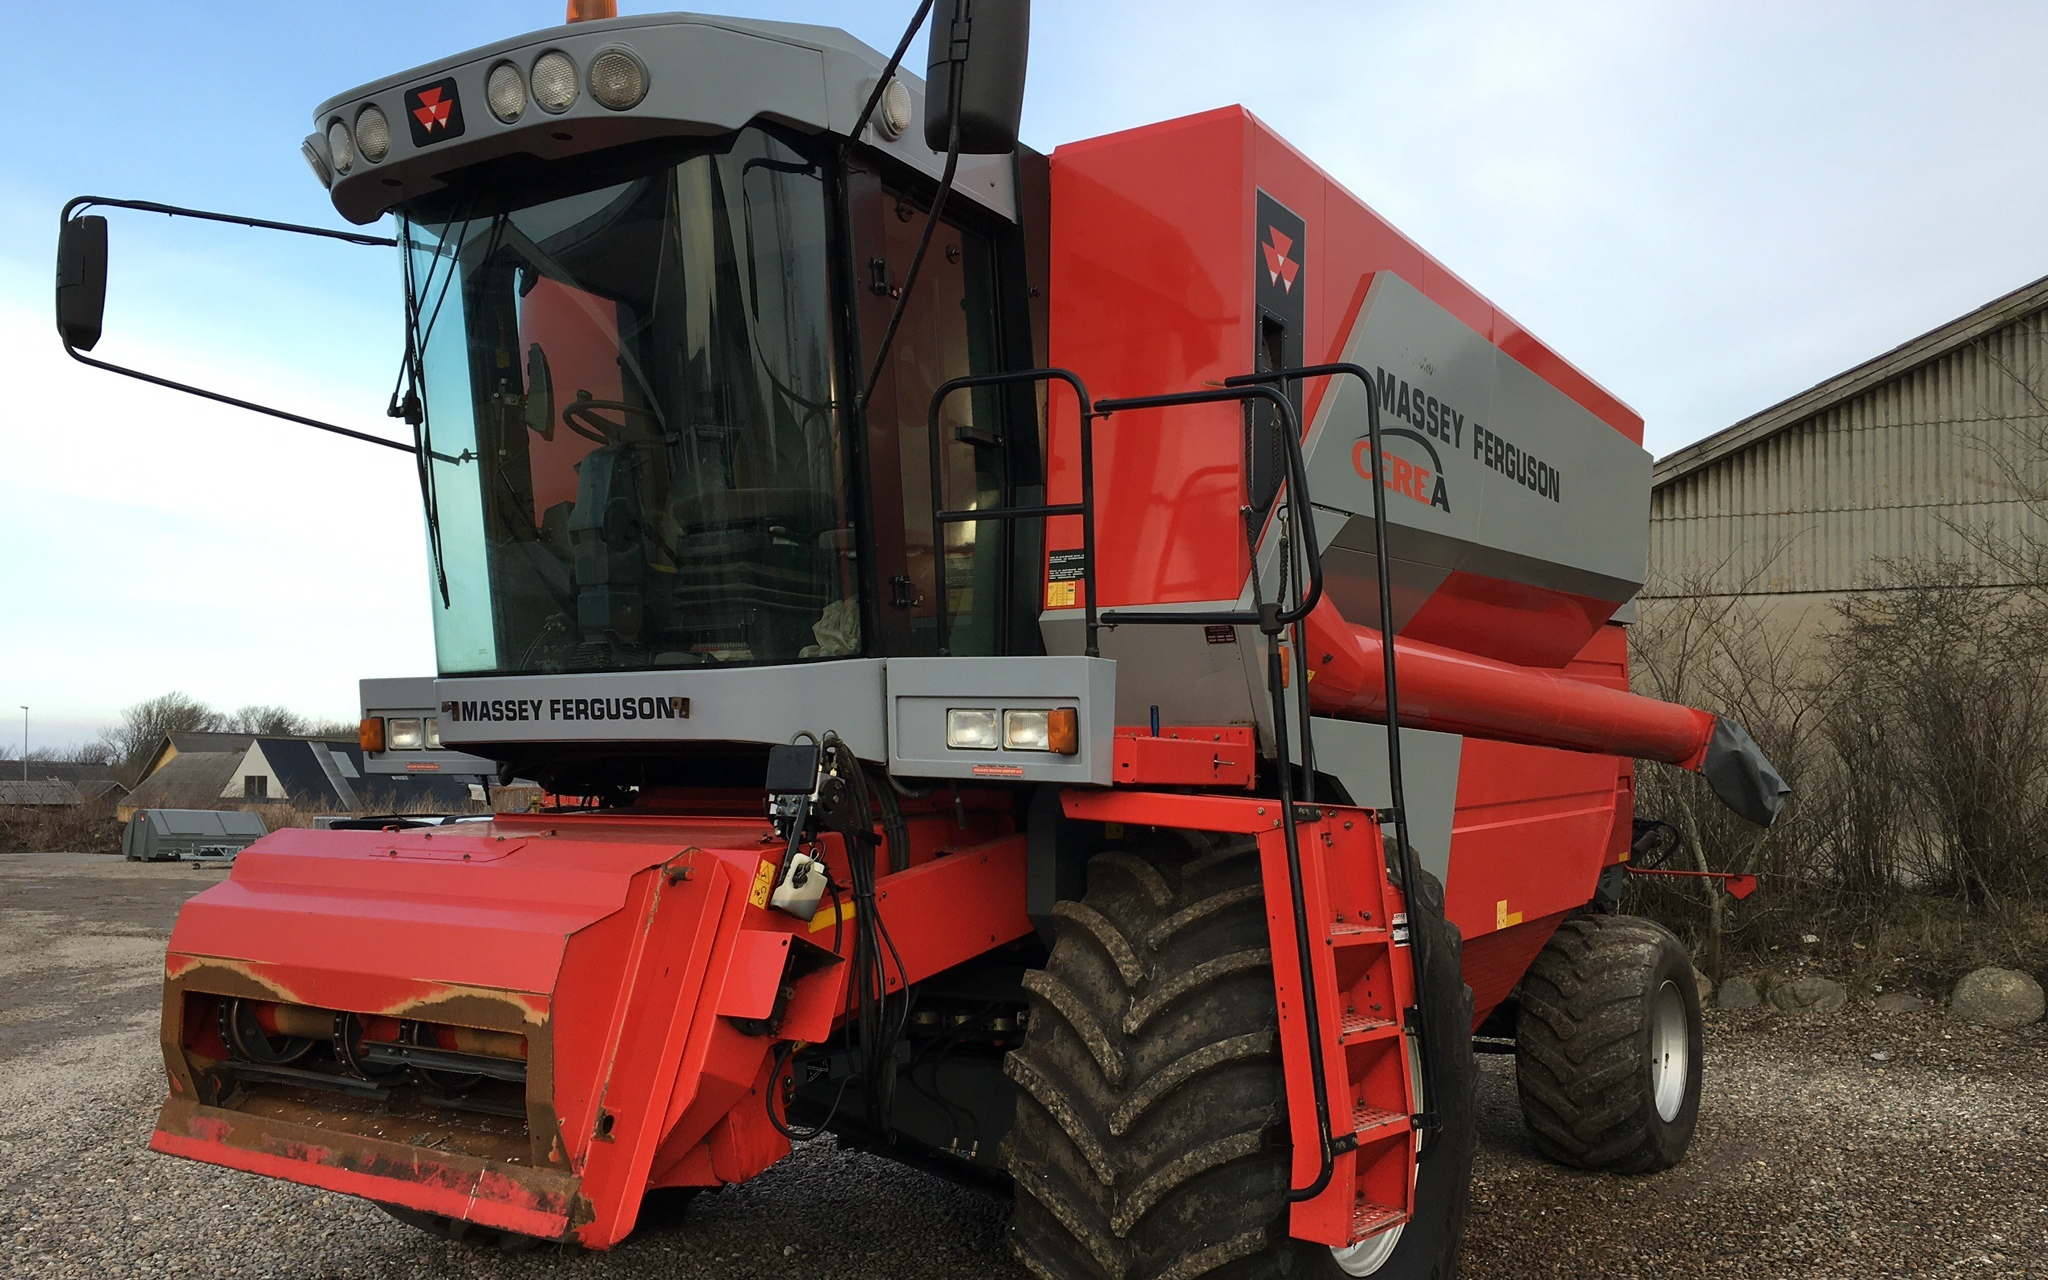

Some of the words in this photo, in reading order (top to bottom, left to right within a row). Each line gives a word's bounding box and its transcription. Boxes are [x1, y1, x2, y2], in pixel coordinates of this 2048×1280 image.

[1377, 366, 1464, 449] MASSEY
[1474, 423, 1560, 503] FERGUSON
[462, 700, 543, 721] MASSEY
[550, 697, 675, 720] FERGUSON
